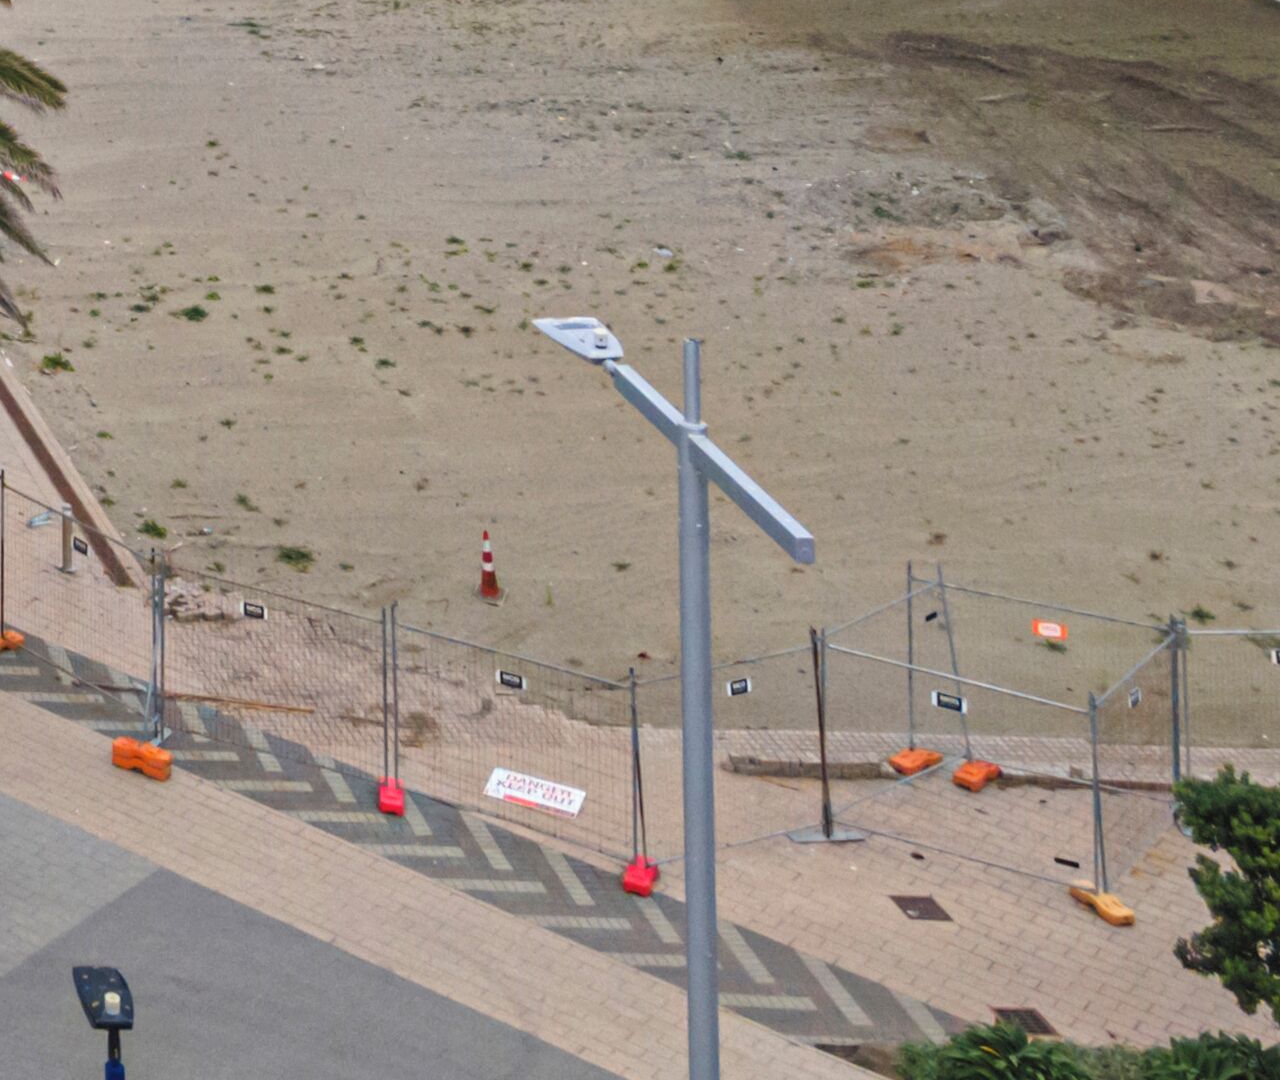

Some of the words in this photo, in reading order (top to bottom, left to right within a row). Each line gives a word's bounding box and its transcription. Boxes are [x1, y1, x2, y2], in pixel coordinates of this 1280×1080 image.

[496, 778, 537, 795] KEEP
[542, 792, 576, 806] OUT
[506, 773, 572, 798] DANGER
